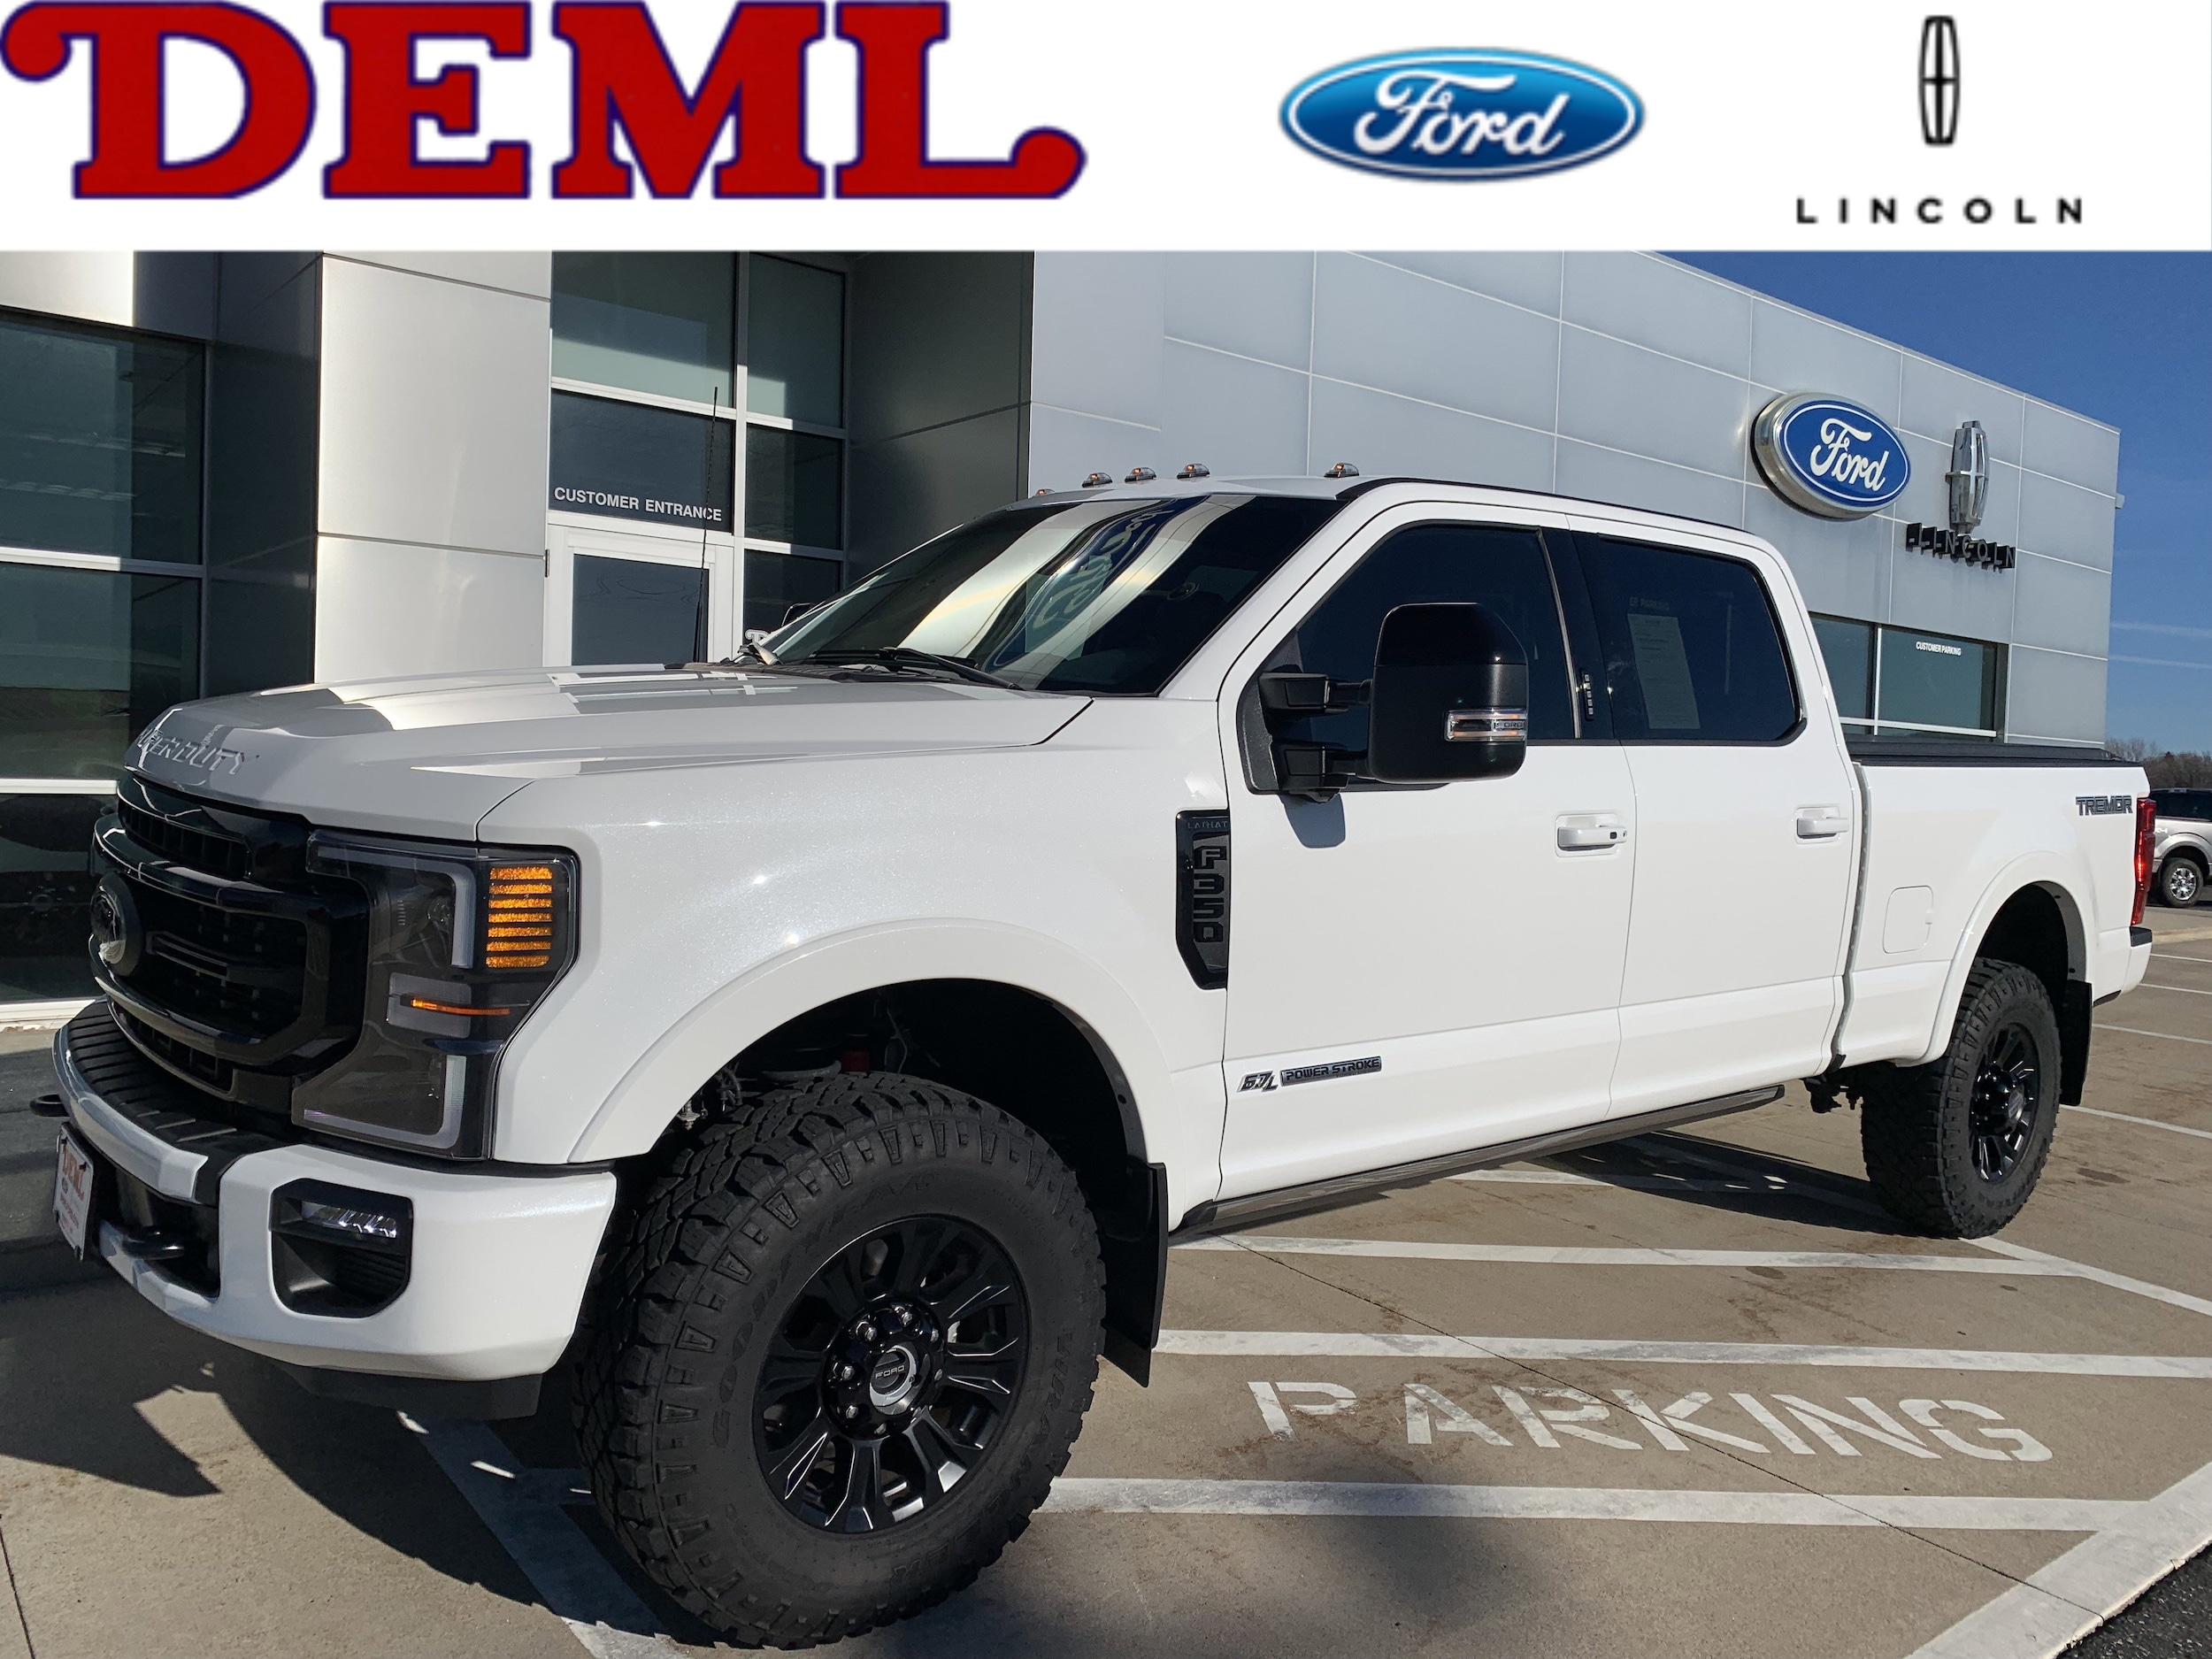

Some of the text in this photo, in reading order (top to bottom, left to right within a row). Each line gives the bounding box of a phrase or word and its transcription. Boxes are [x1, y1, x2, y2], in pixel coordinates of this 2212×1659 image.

[1809, 418, 1890, 492] Ford
[554, 487, 722, 522] CUSTOMER ENTRANCE
[1906, 522, 2016, 569] LINCOLN
[1916, 641, 1962, 656] CUSTOMER PARKING
[2075, 795, 2133, 816] TREMOR
[1286, 1066, 1328, 1081] POWER
[1333, 1058, 1379, 1074] STROKE
[875, 1364, 905, 1379] FORD
[1246, 1380, 2053, 1463] PARKING
